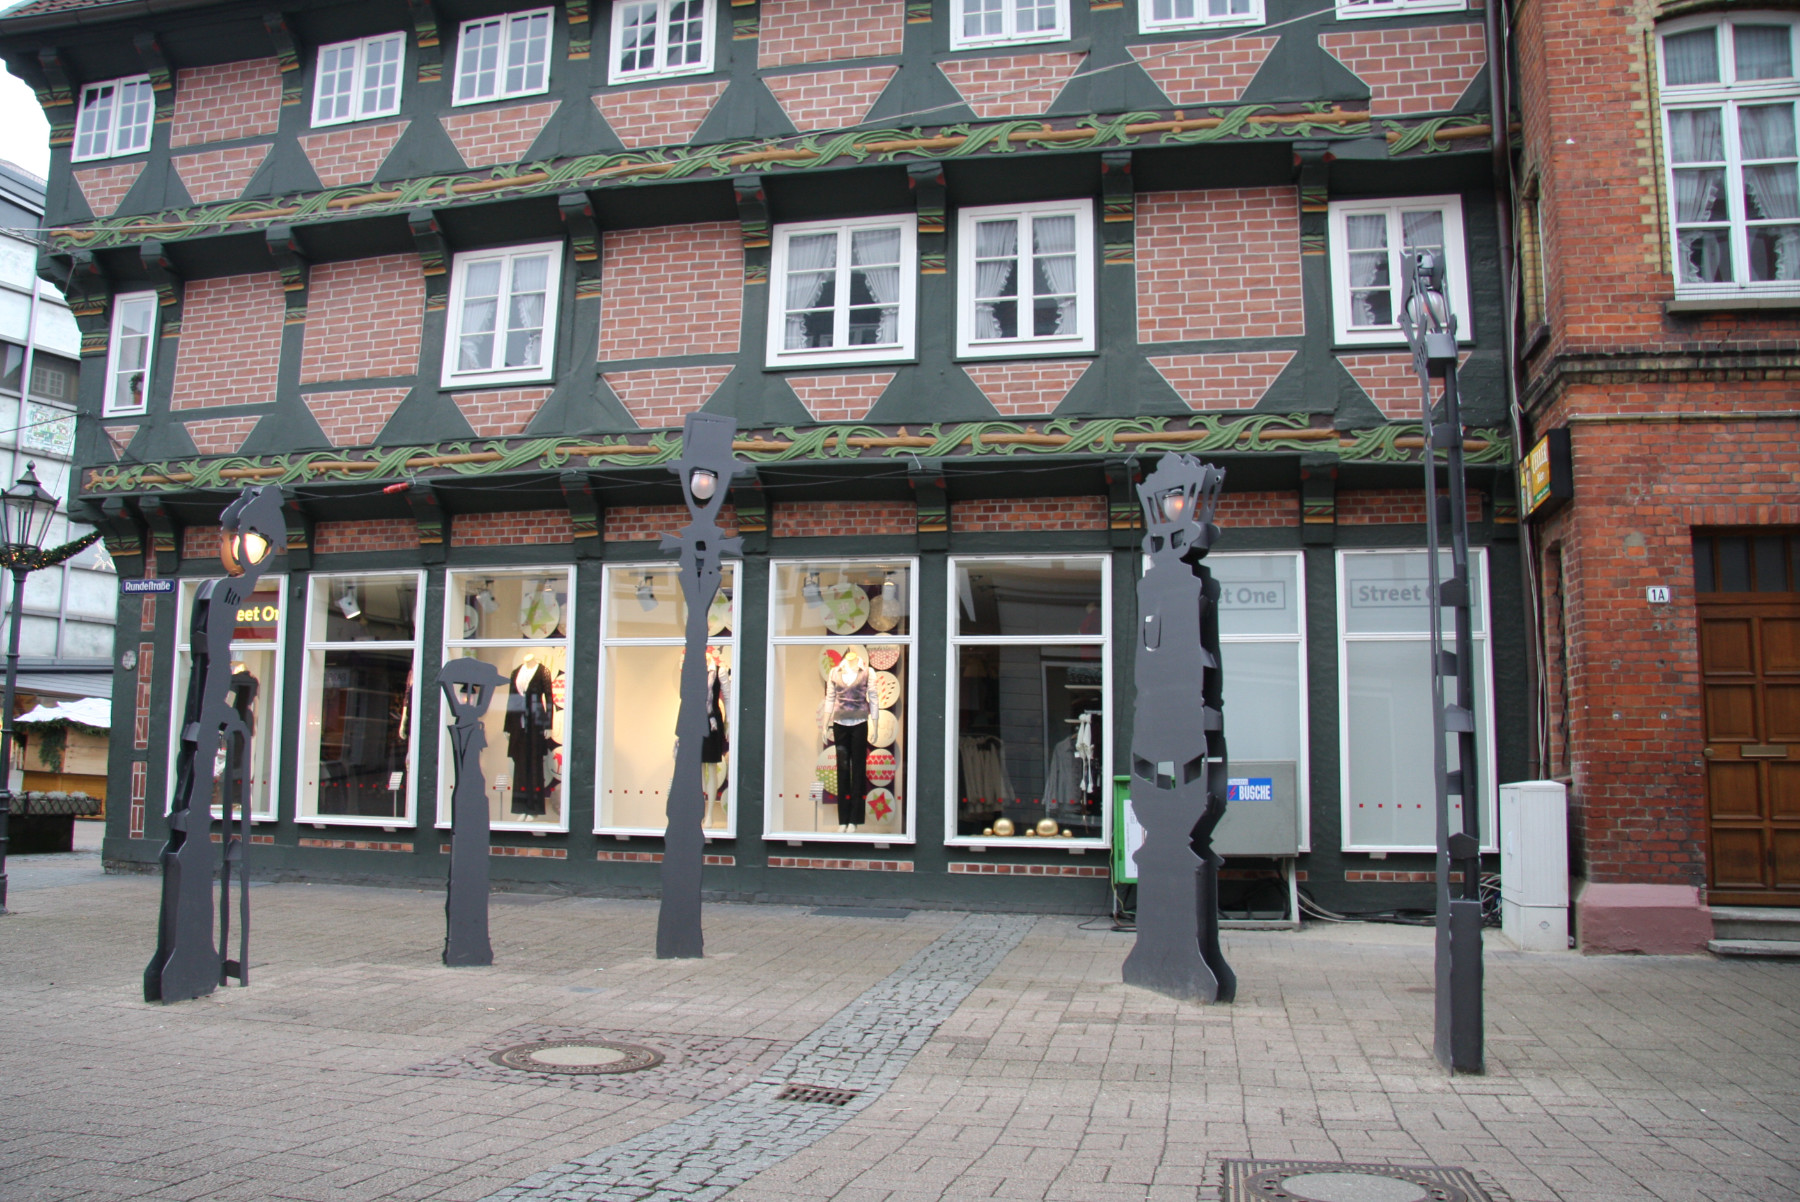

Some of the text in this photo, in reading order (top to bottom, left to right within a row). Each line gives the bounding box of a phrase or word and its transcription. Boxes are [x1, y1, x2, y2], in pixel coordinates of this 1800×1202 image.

[1237, 588, 1277, 604] One
[1359, 585, 1422, 602] Street
[1651, 589, 1665, 601] 1A
[236, 606, 260, 622] eet
[1239, 785, 1271, 801] BUSCHE
